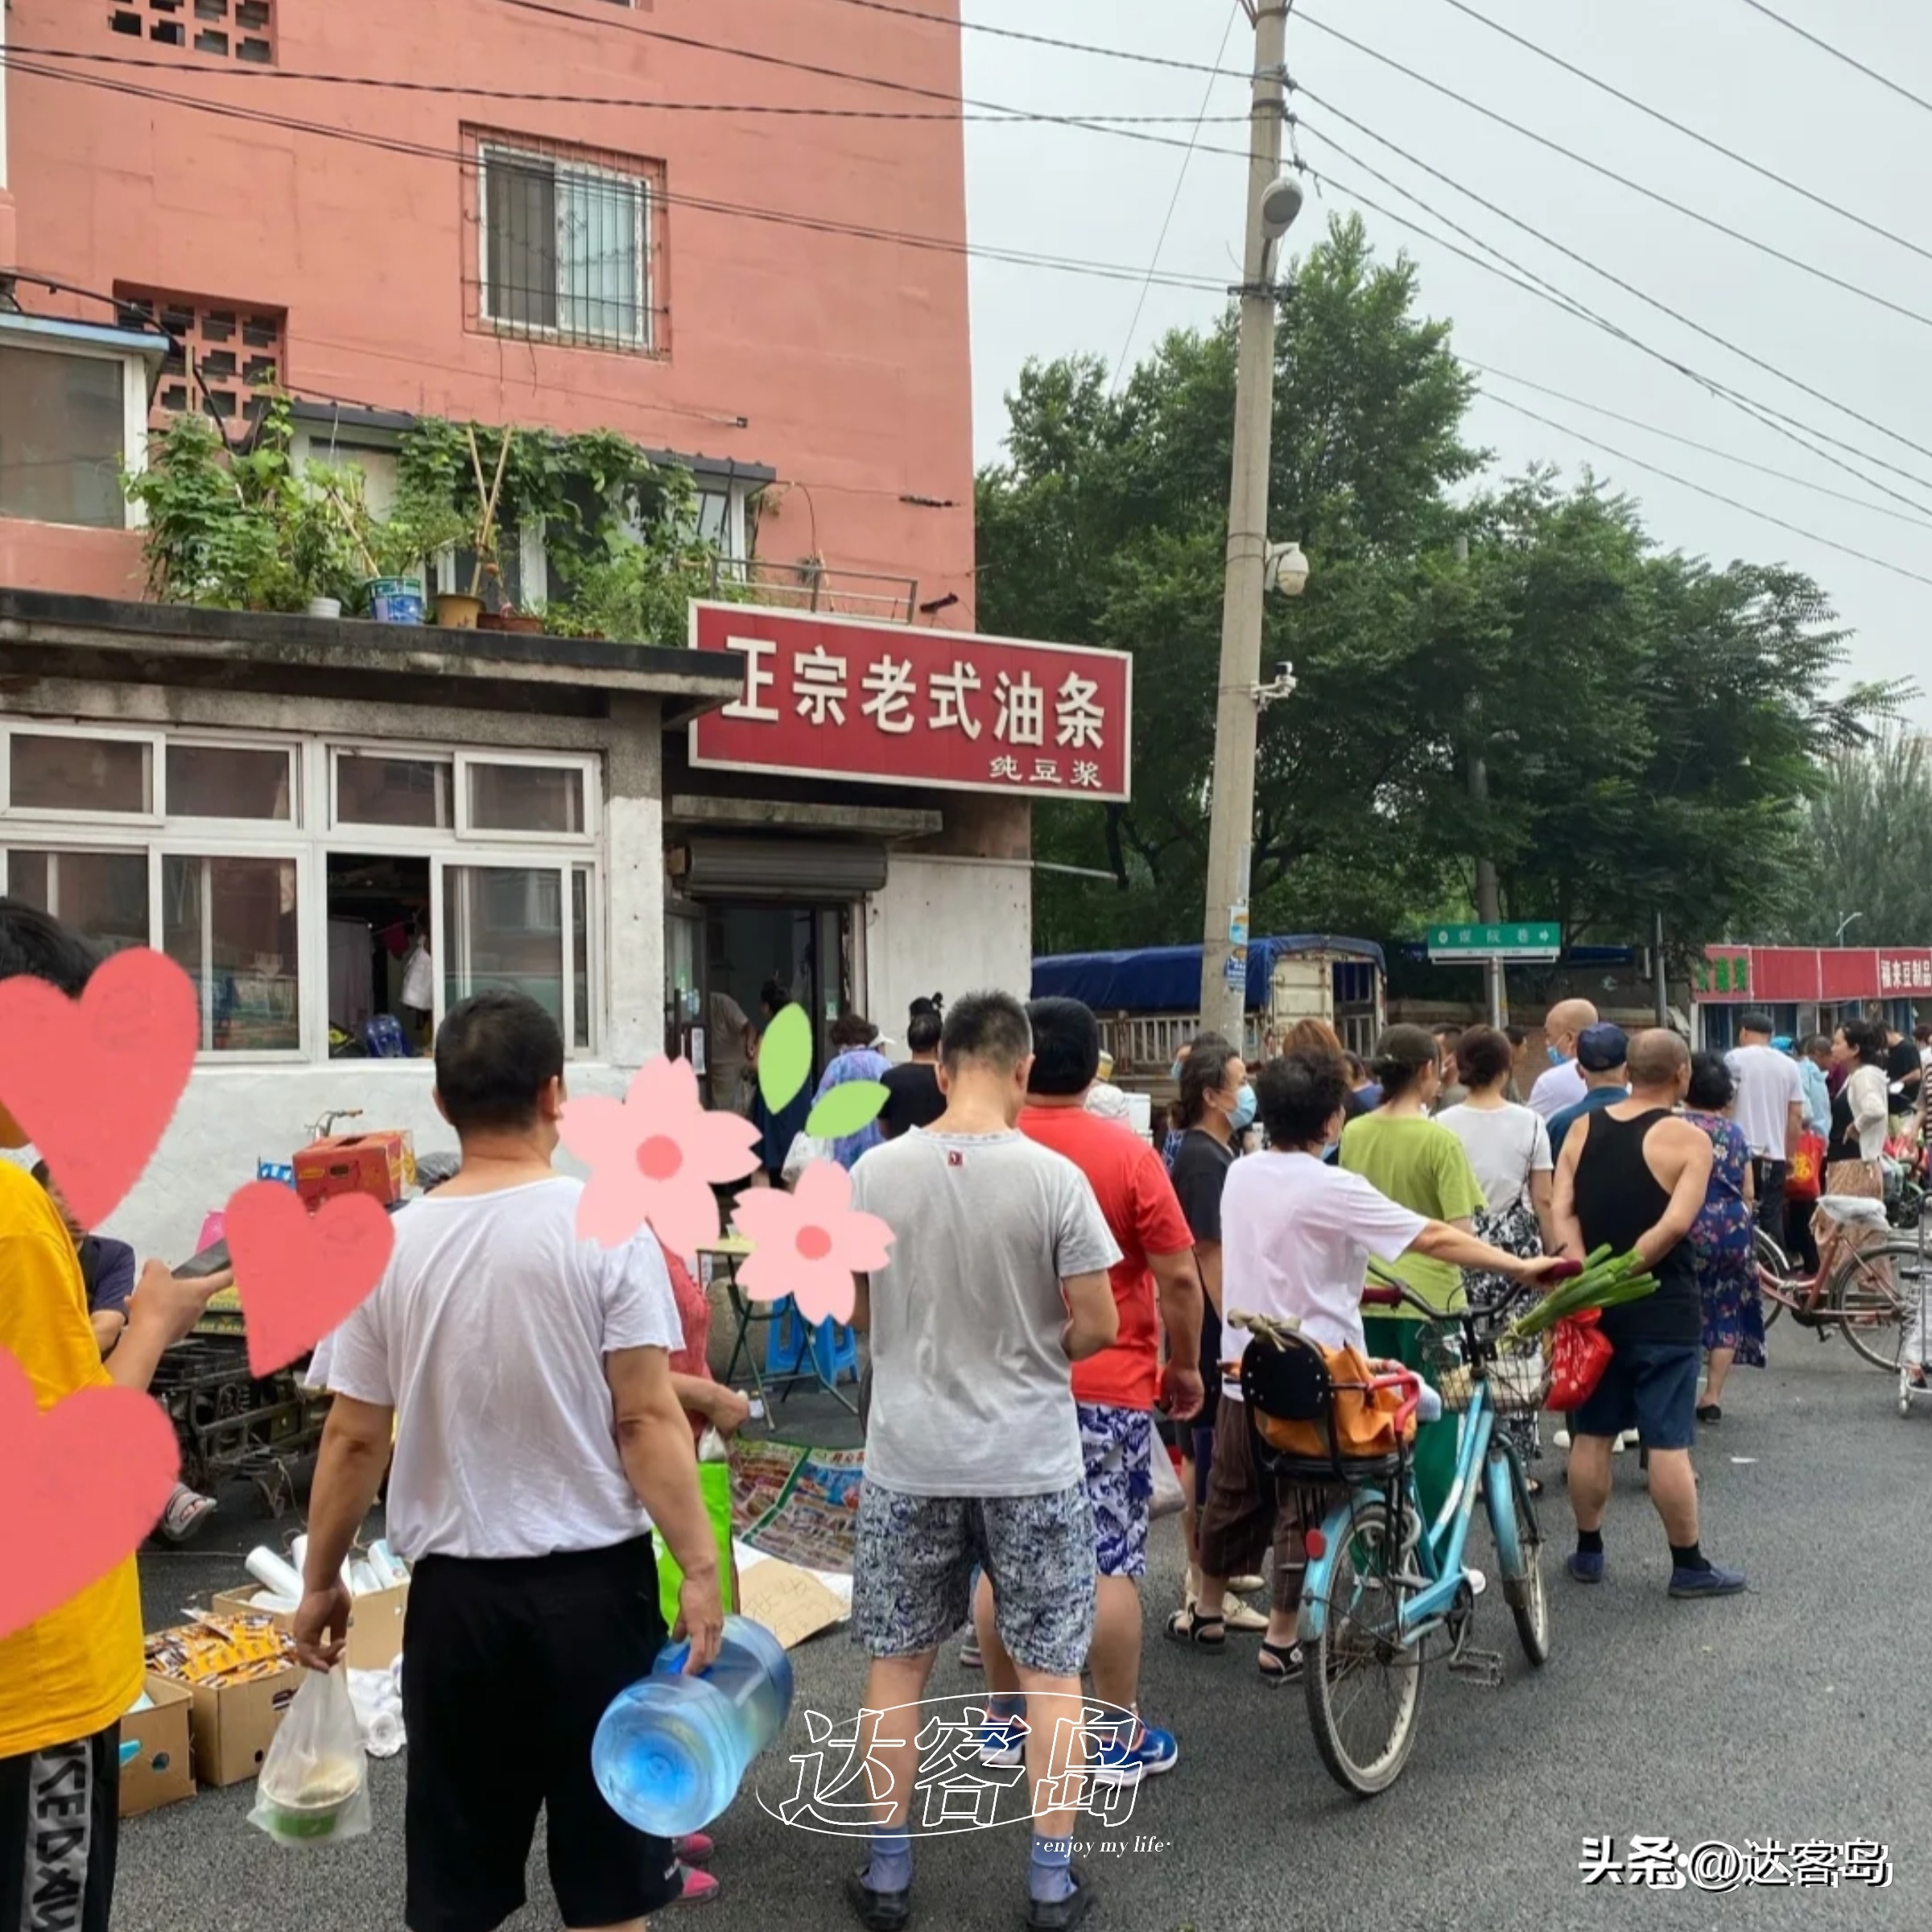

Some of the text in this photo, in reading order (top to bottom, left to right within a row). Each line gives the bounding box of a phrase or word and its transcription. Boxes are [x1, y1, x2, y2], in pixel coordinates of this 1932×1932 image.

[722, 634, 1104, 749] 正宗老式油条
[989, 754, 1103, 789] 纯豆浆
